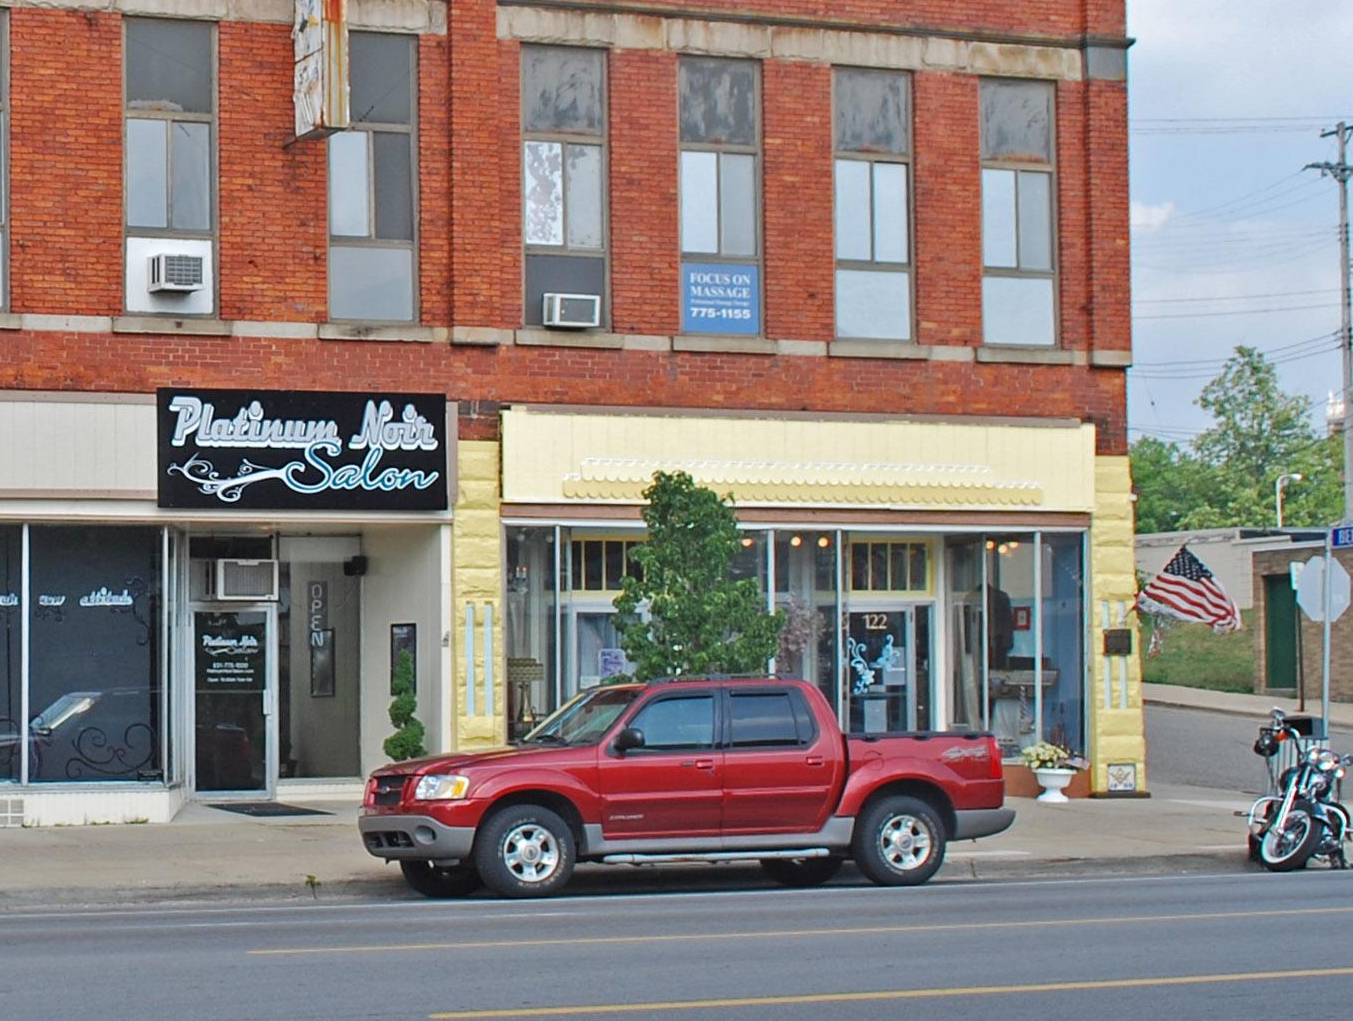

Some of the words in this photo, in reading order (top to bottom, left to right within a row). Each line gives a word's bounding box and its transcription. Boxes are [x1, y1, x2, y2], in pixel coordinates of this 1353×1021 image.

[690, 272, 731, 284] FOCUS
[732, 274, 750, 285] ON
[690, 286, 750, 298] MASSAGE
[690, 307, 751, 319] 775-1155
[169, 395, 342, 448] Platinum
[348, 400, 439, 451] Noir
[285, 440, 440, 495] Salon
[310, 583, 324, 647] OPEN
[861, 613, 887, 629] 122
